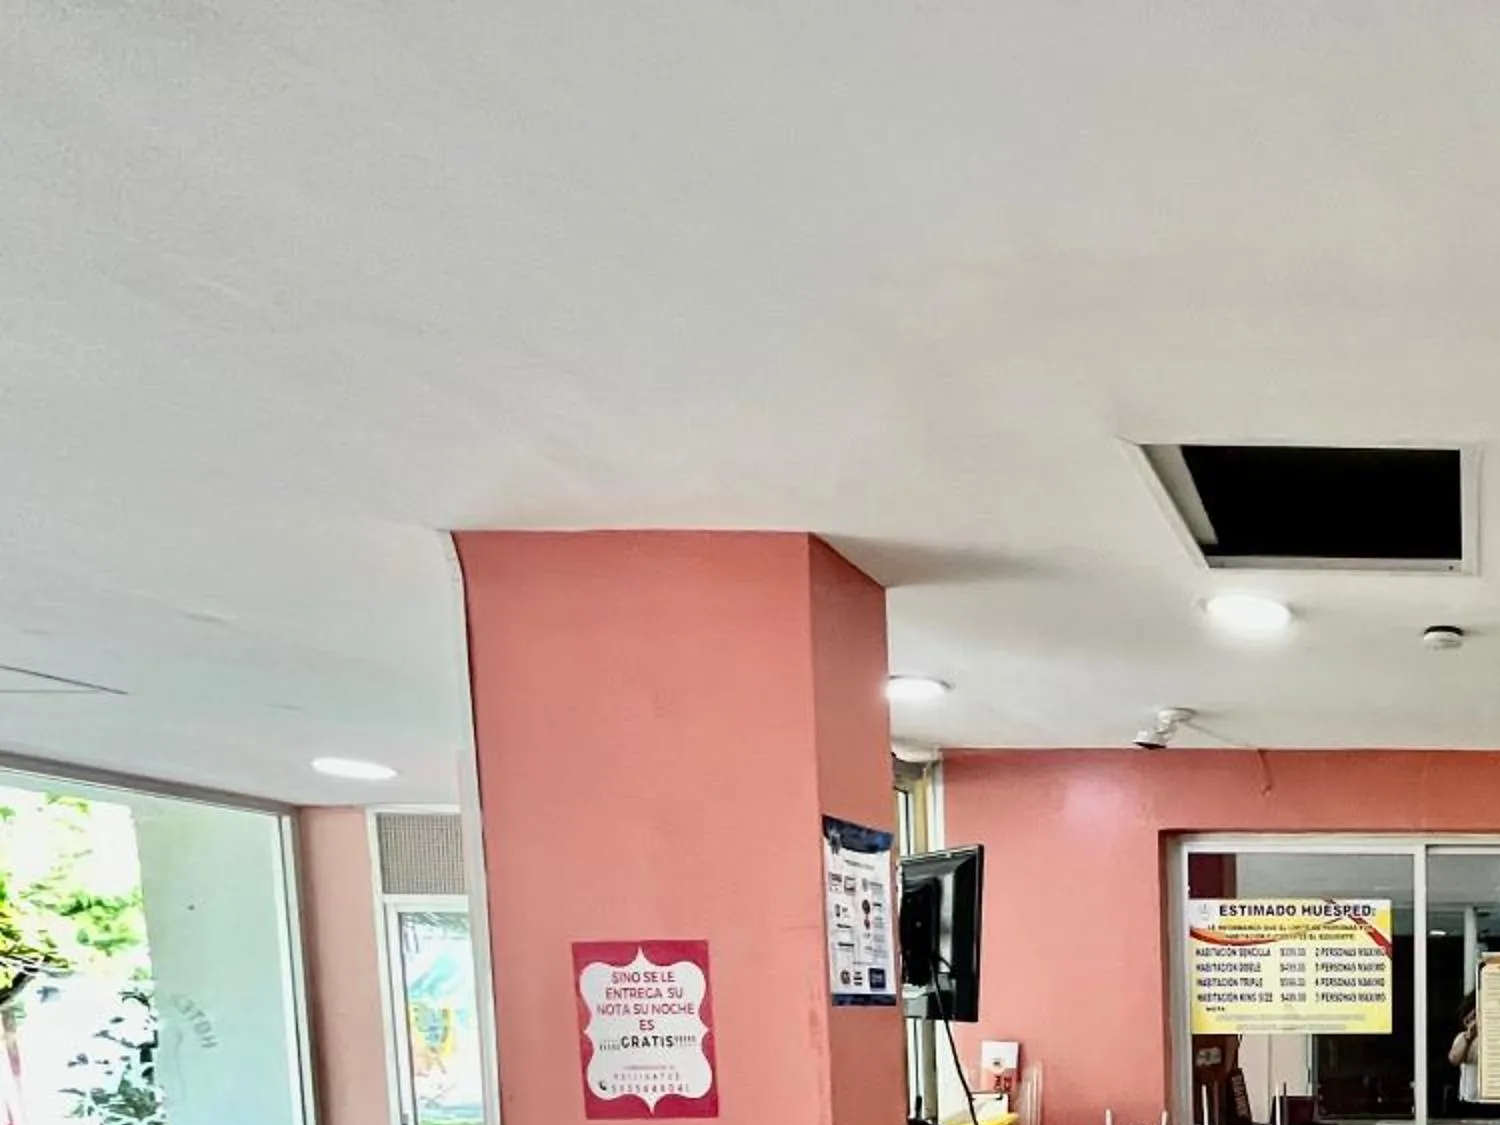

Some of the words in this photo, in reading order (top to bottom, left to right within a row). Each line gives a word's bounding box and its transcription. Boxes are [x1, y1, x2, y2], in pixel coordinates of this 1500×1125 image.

[1219, 905, 1299, 917] ESTIMADO
[643, 972, 660, 983] SE
[661, 971, 676, 983] LE
[606, 987, 663, 999] ENTREGA
[667, 987, 683, 999] SU
[597, 1003, 631, 1015] NOTA
[633, 1003, 649, 1015] SU
[651, 1003, 695, 1015] NOCHE
[639, 1019, 655, 1031] ES
